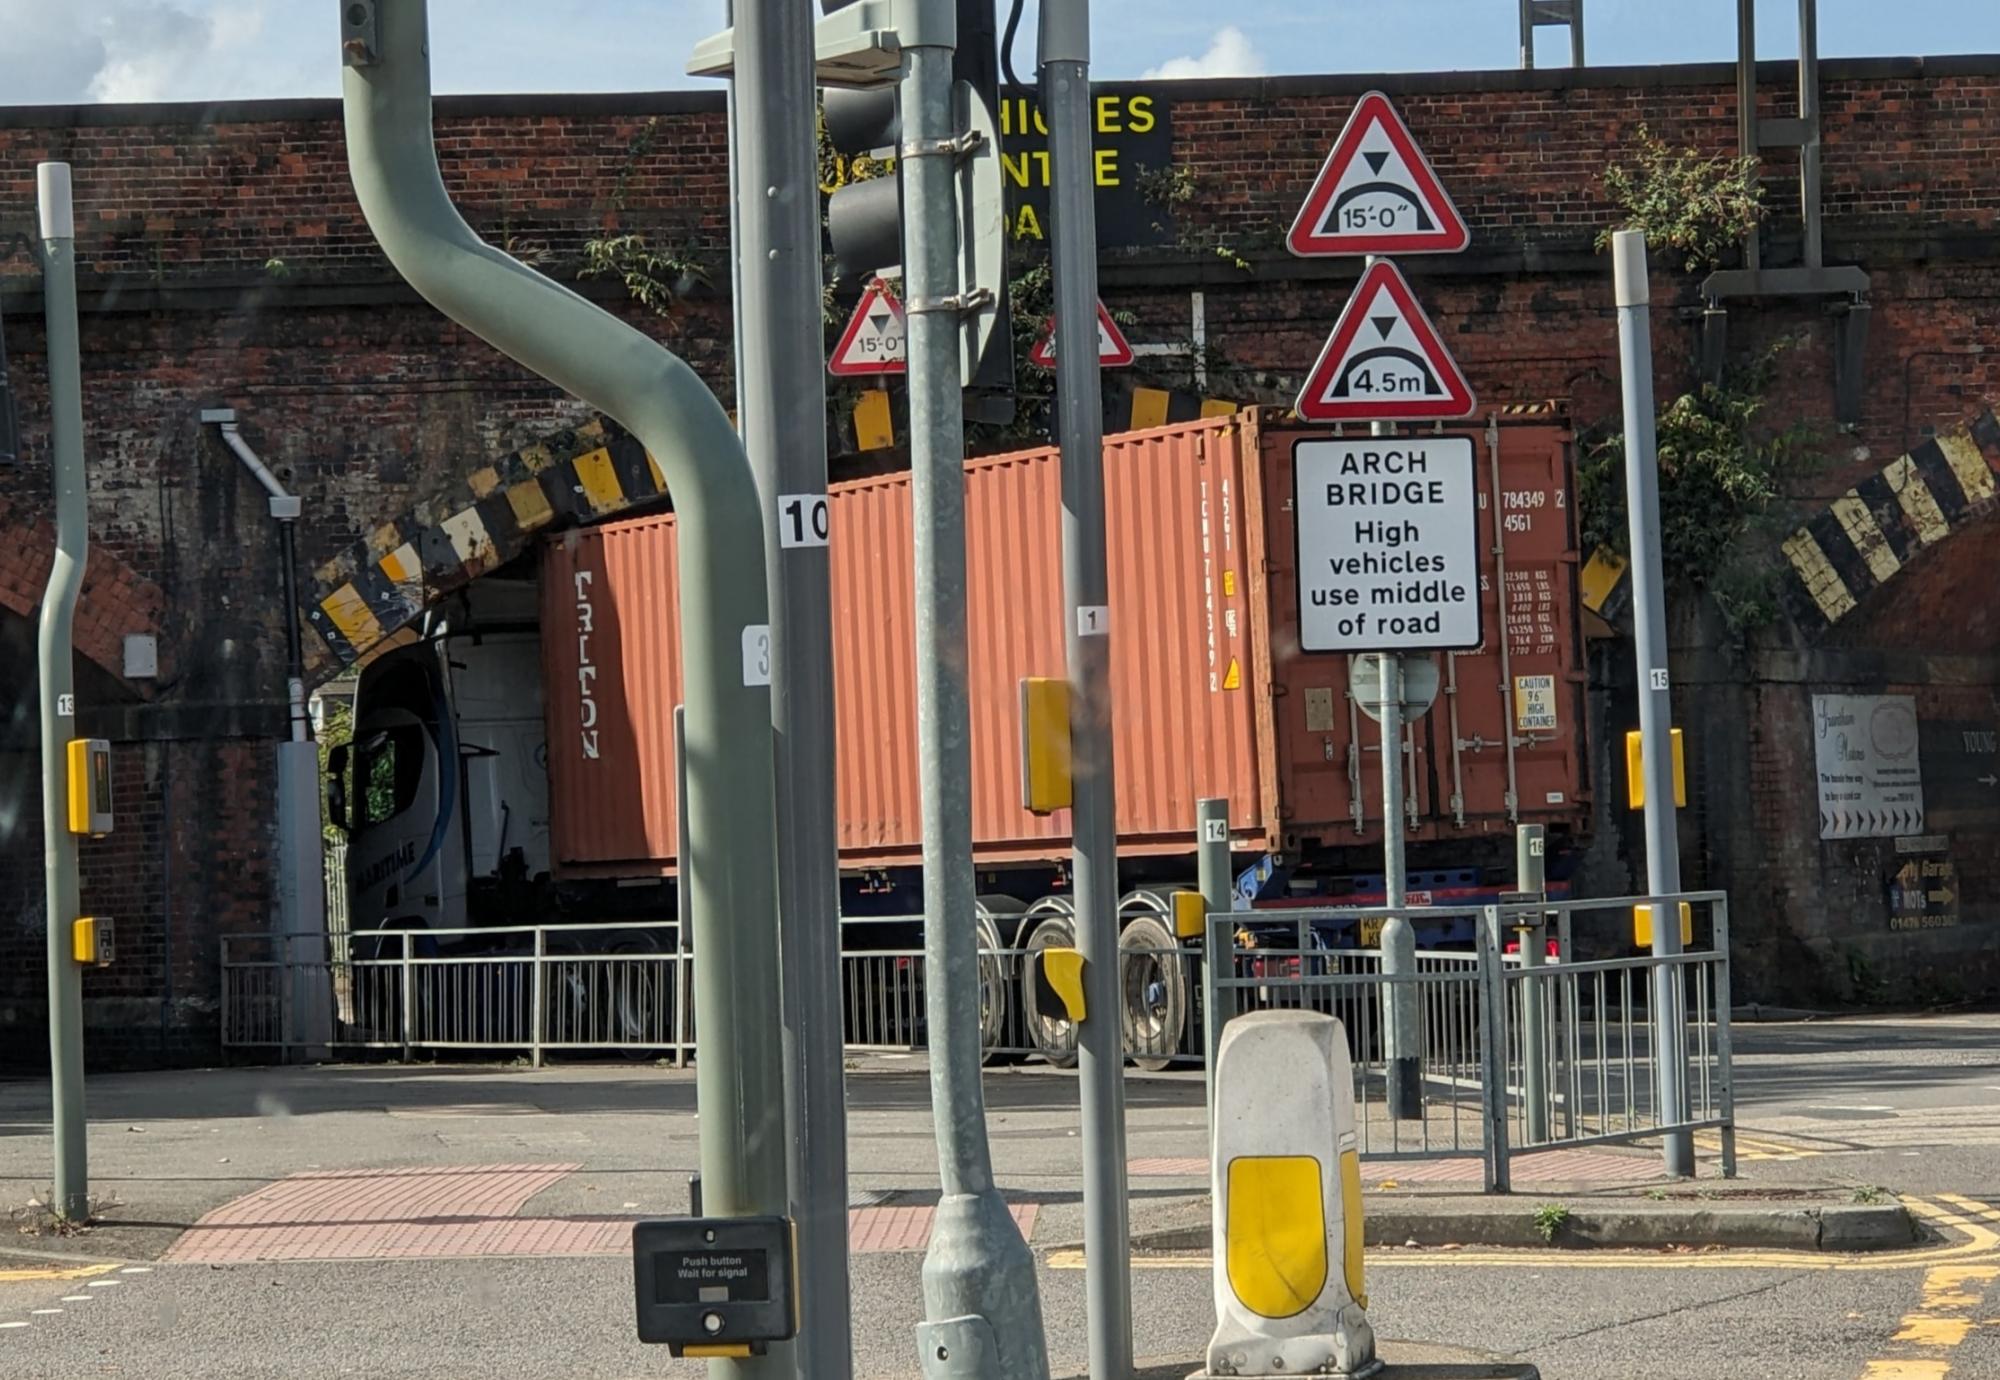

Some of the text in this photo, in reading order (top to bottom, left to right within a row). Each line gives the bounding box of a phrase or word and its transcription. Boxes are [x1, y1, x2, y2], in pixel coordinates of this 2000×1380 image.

[1353, 369, 1421, 393] 4.5m
[1340, 451, 1427, 475] ARCH
[1326, 481, 1445, 506] BRIDGE
[1502, 491, 1545, 508] 784349
[1556, 491, 1565, 508] 2
[786, 500, 829, 542] 10
[1504, 514, 1532, 532] 45G1
[1354, 521, 1420, 547] High
[1329, 551, 1446, 575] vehicles
[1311, 587, 1359, 606] use
[1371, 581, 1466, 604] middle
[1337, 611, 1441, 636] of road
[1518, 678, 1551, 690] CAUTION
[1652, 672, 1668, 687] 15
[1527, 703, 1545, 715] HIGH
[1518, 715, 1556, 728] CONTAINER
[1207, 823, 1226, 840] 14
[683, 1256, 742, 1267] Push button
[678, 1267, 748, 1279] Wait for signal
